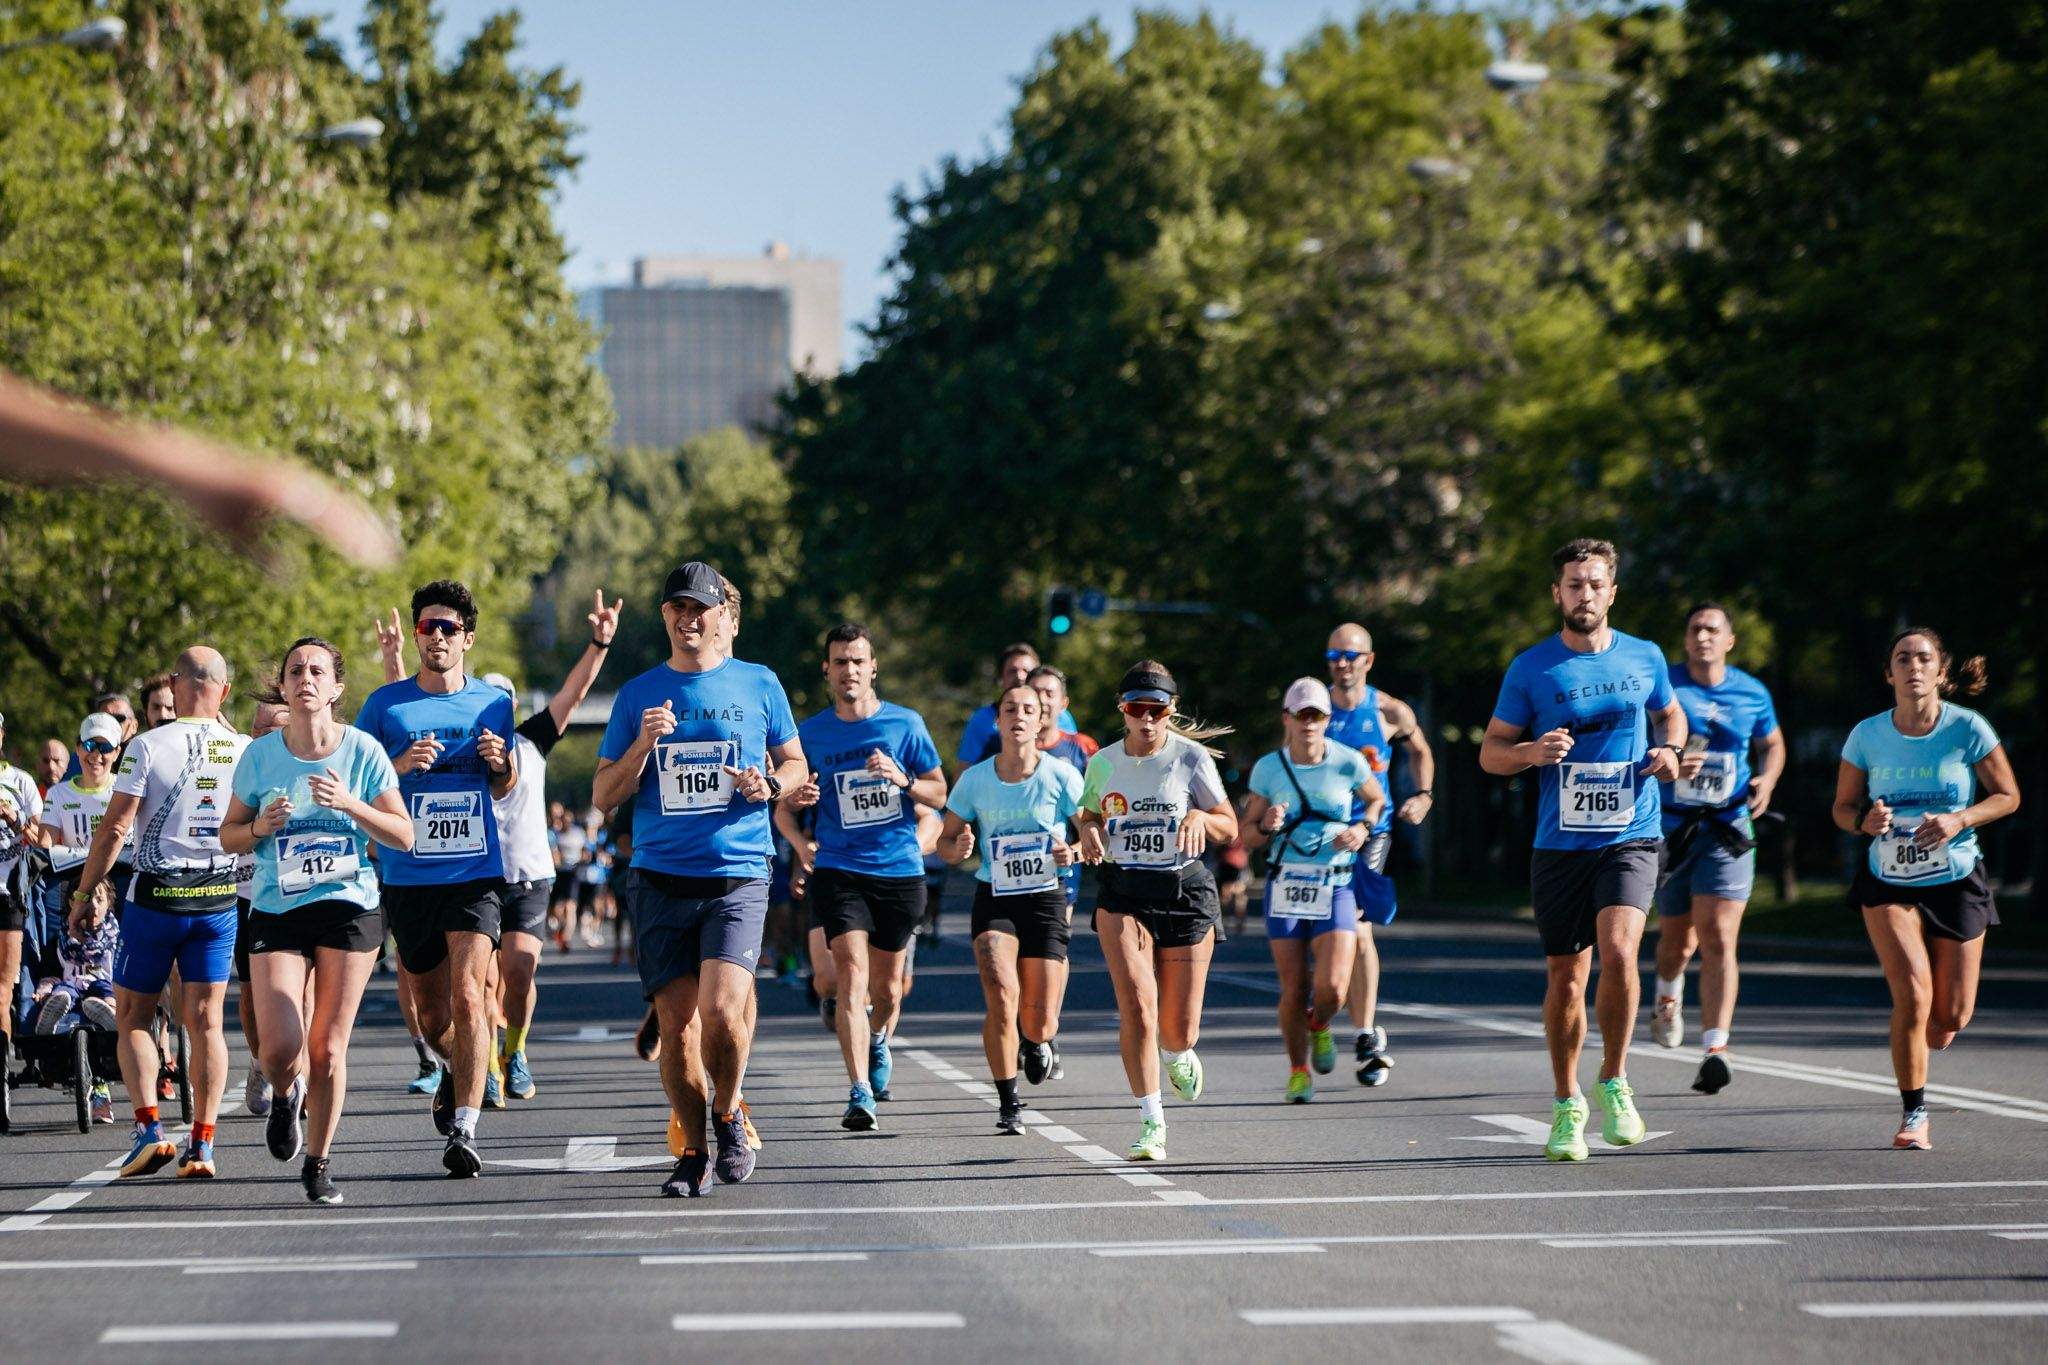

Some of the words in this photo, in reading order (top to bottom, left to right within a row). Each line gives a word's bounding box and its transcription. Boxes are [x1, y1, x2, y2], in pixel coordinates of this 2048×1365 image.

[1555, 680, 1641, 704] DECIMAS
[682, 751, 721, 759] BOMBEROS
[679, 763, 721, 772] DECIMAS
[675, 771, 720, 794] 1164
[851, 791, 890, 811] 1540
[1131, 800, 1178, 812] Carnes
[1574, 791, 1620, 811] 2165
[427, 819, 470, 840] 2074
[1123, 833, 1165, 853] 1949
[1896, 844, 1930, 864] 805
[301, 856, 336, 875] 412
[1004, 857, 1045, 878] 1802
[1284, 886, 1319, 903] 1367
